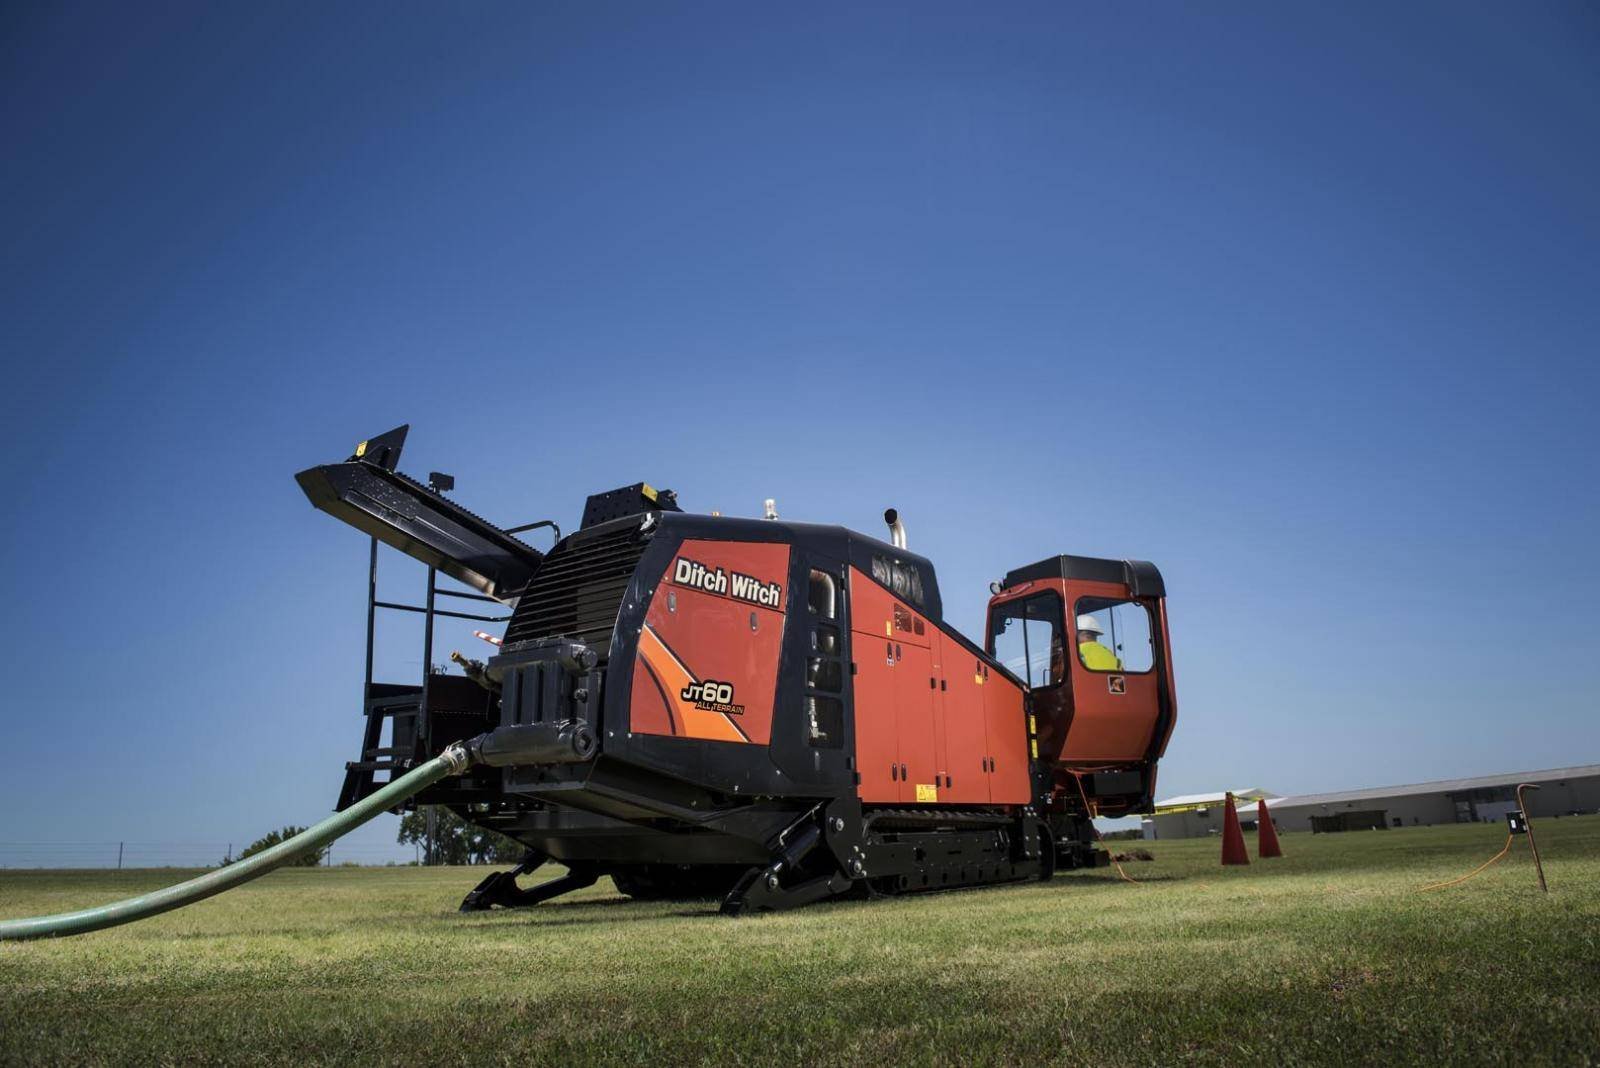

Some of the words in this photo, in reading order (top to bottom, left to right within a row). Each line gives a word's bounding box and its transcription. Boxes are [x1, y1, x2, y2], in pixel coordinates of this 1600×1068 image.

[675, 559, 727, 593] Ditch
[732, 573, 780, 607] Witch
[682, 682, 733, 704] JT60
[696, 701, 711, 710] ALL
